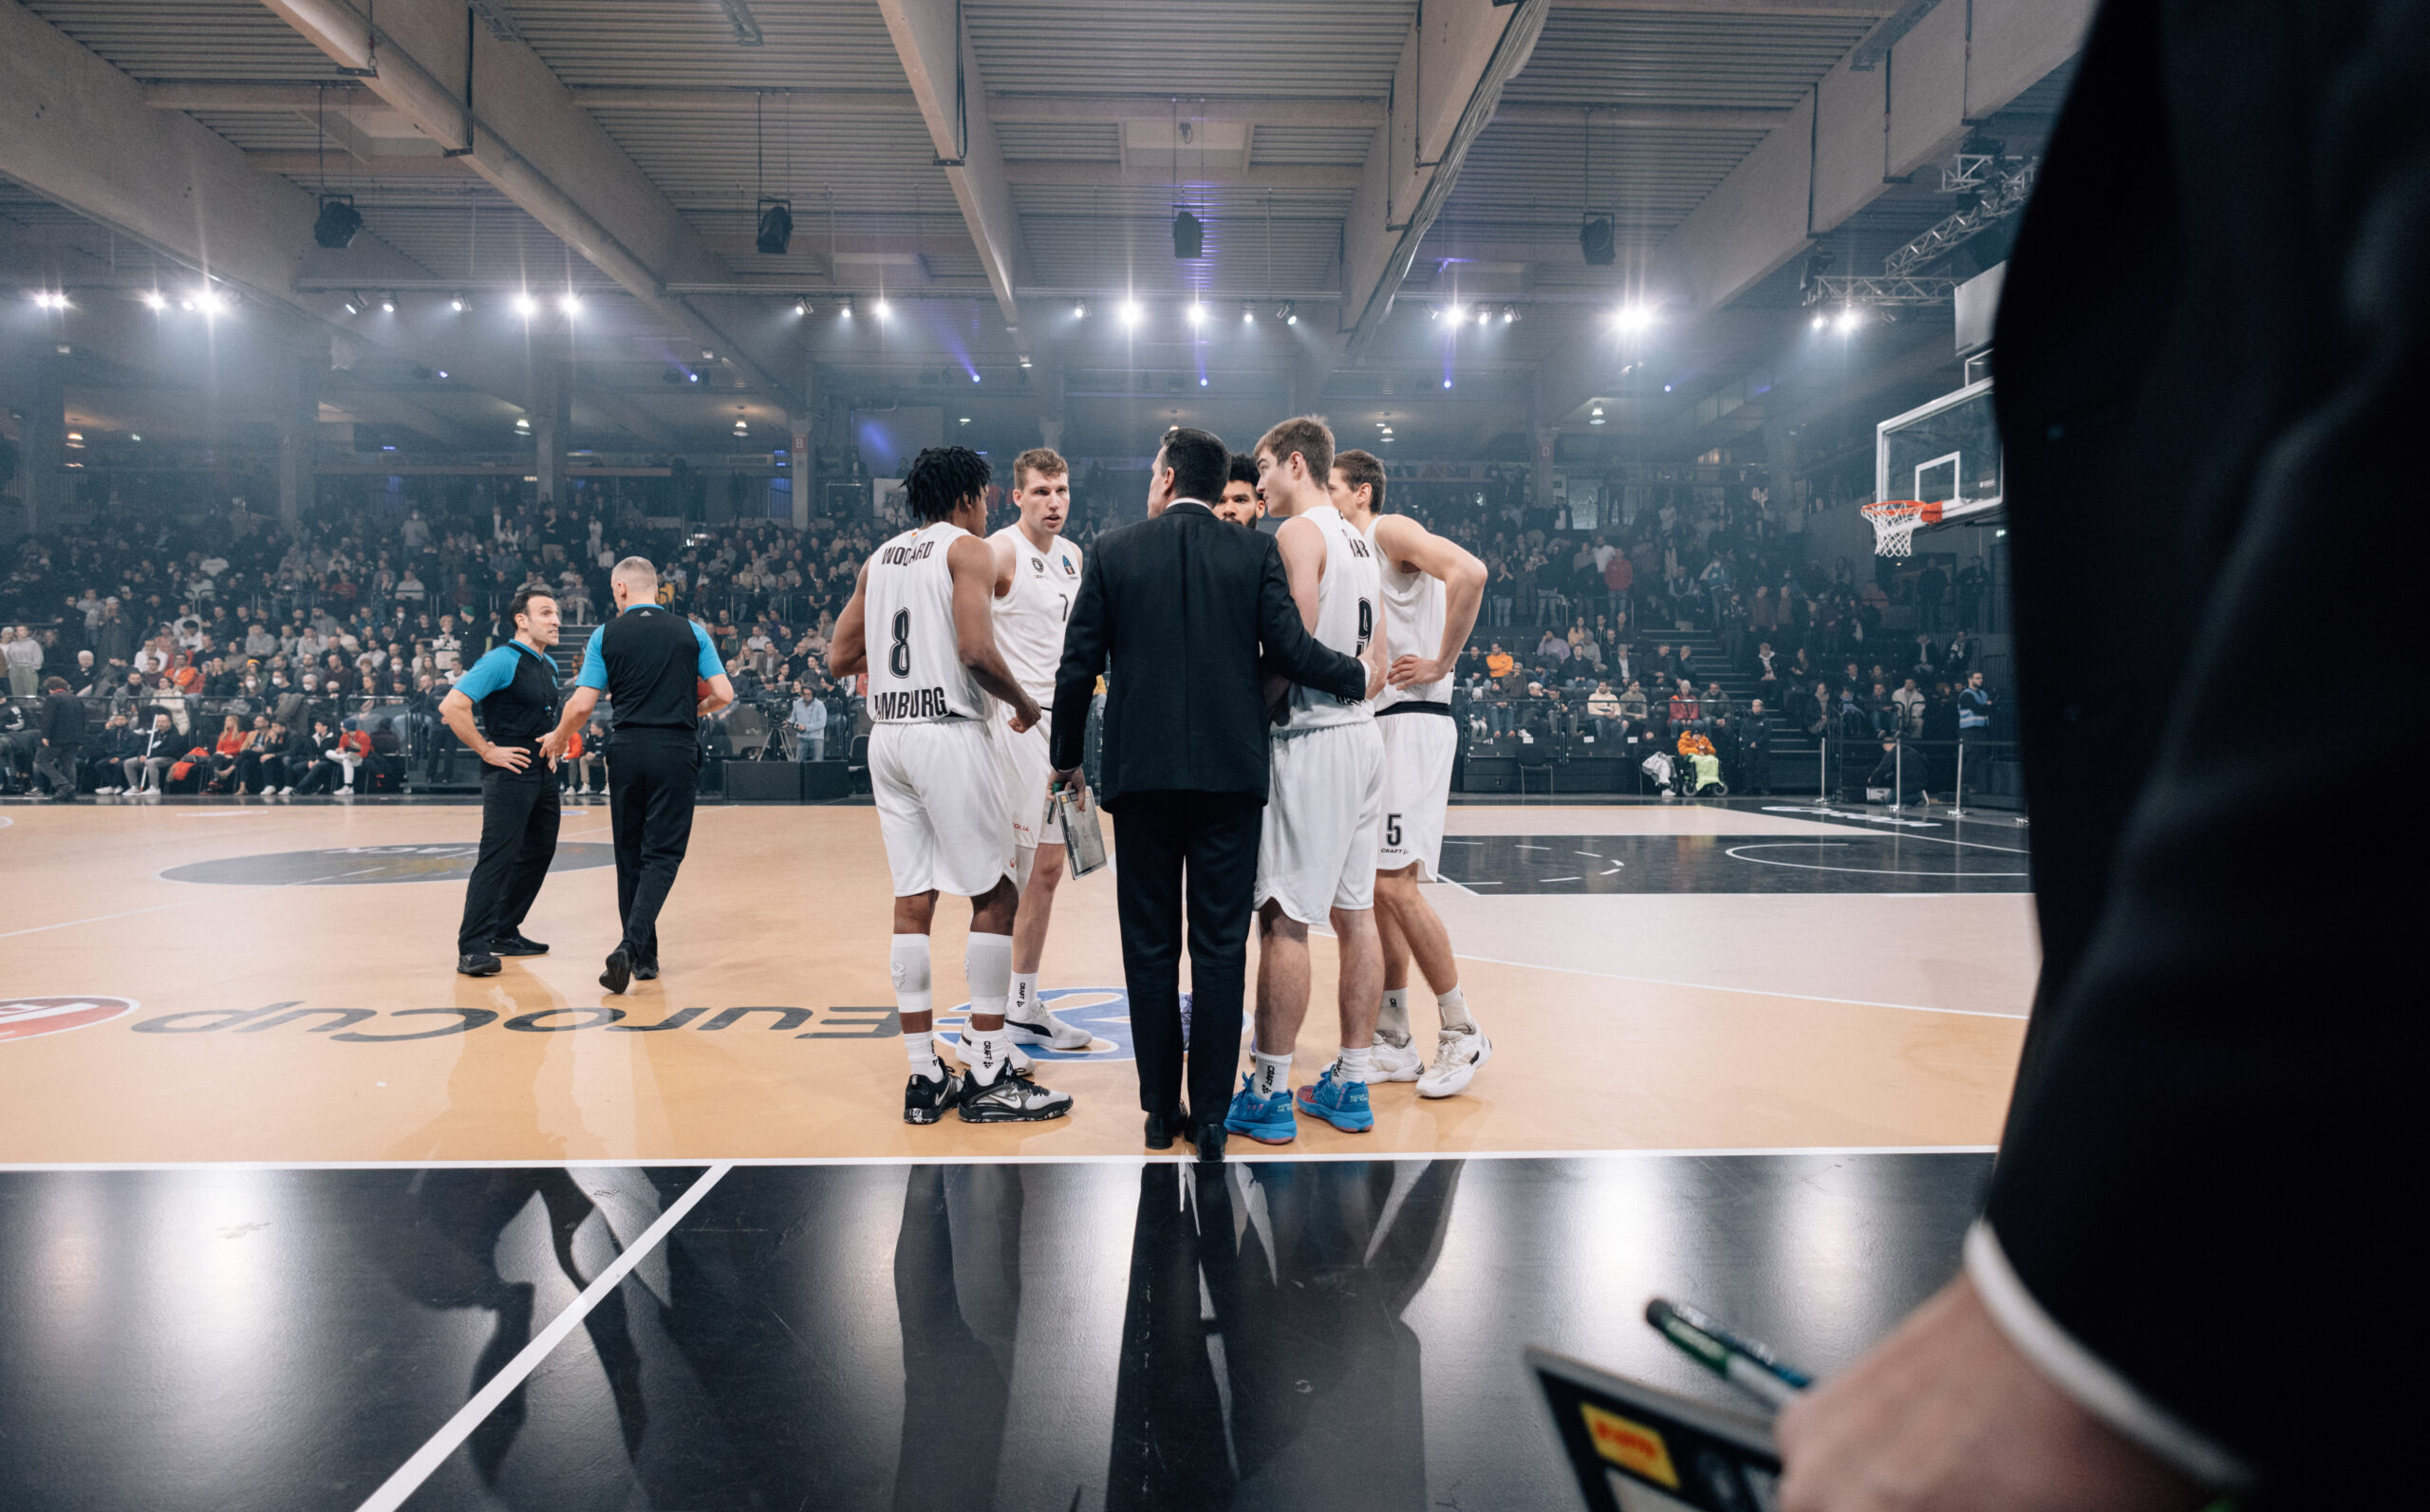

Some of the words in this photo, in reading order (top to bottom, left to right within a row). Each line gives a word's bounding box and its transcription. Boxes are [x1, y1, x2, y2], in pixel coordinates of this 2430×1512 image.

[795, 438, 803, 449] B
[1058, 592, 1070, 623] 7
[888, 607, 911, 680] 8
[1386, 812, 1403, 847] 5
[981, 1040, 993, 1060] CRAFT
[1266, 1065, 1276, 1086] CRAFT
